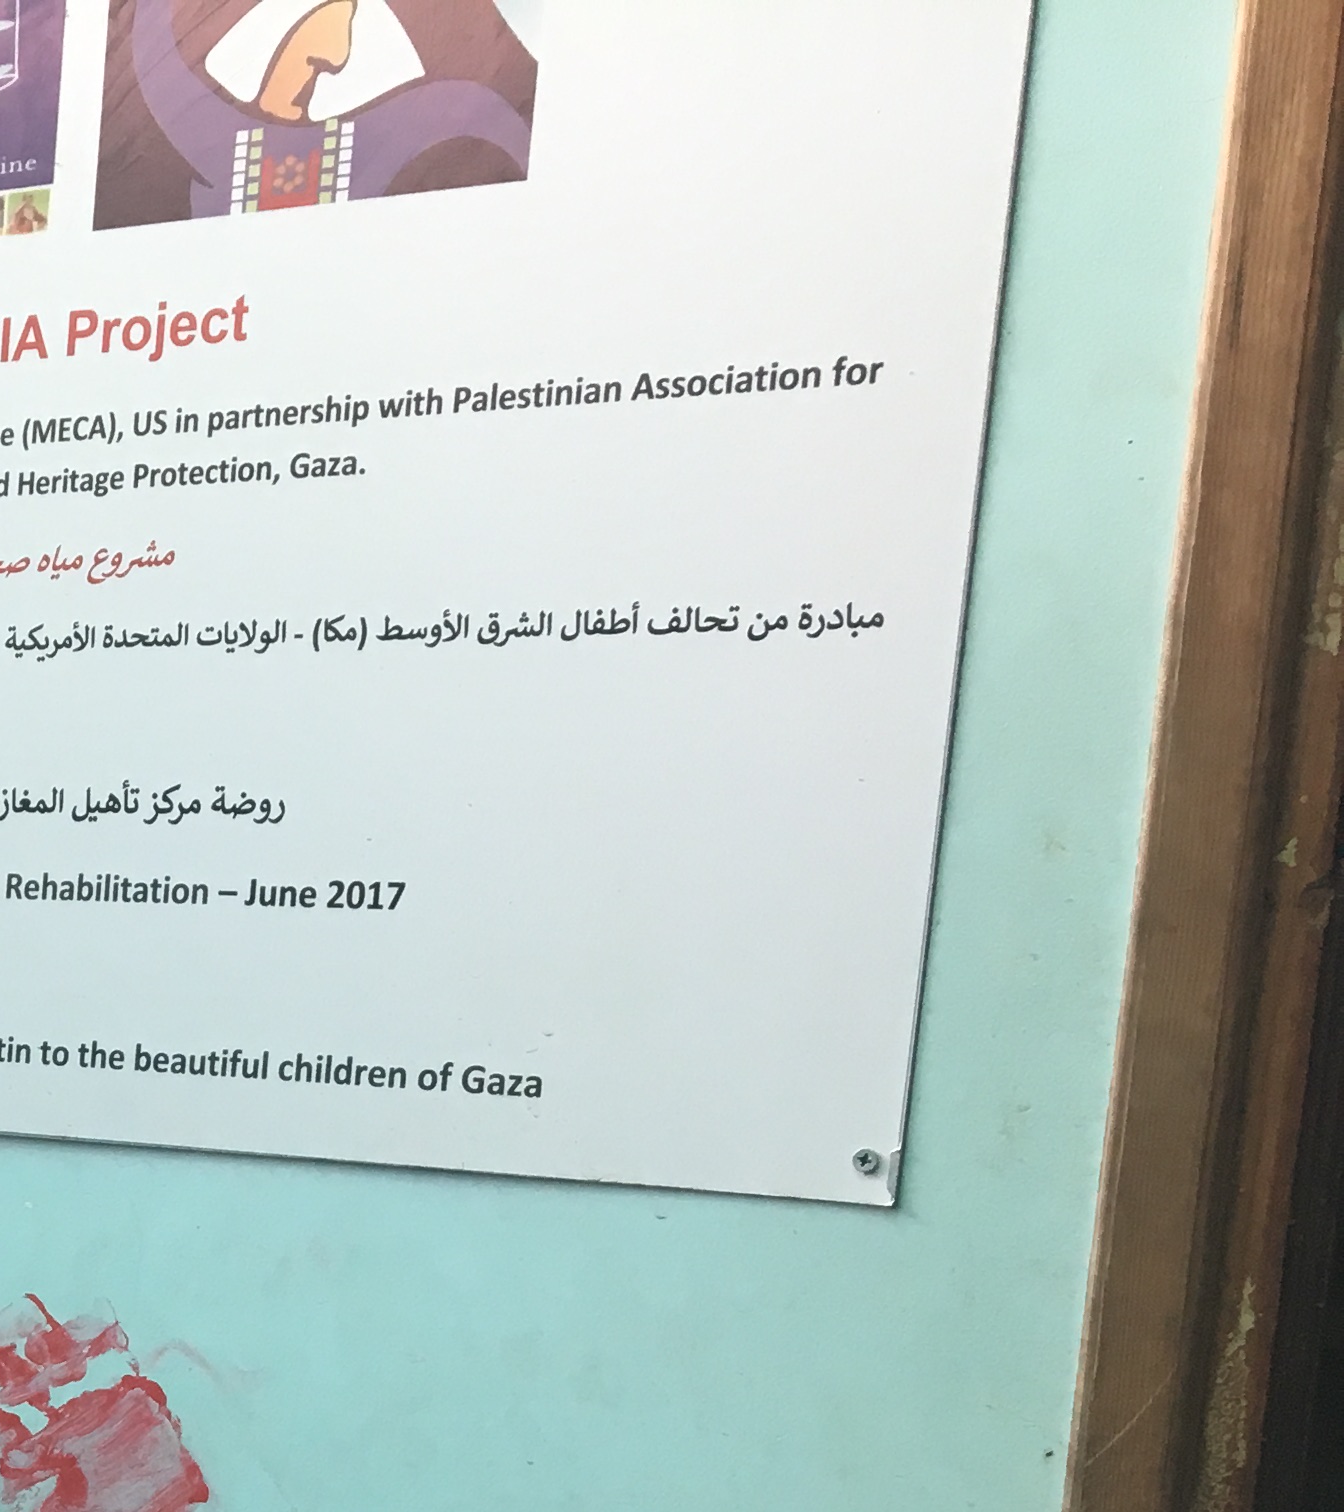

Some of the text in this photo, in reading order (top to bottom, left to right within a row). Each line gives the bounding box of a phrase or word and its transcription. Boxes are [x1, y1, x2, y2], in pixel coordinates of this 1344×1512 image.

[64, 293, 250, 362] Project
[20, 411, 125, 452] (MECA),
[132, 408, 168, 437] US
[175, 405, 199, 434] in
[207, 391, 371, 436] partnership
[378, 386, 444, 419] with
[452, 377, 623, 415] Palestinian
[630, 362, 823, 402] Association
[832, 355, 885, 388] for
[16, 461, 126, 499] Heritage
[132, 453, 282, 491] Protection,
[289, 451, 368, 481] Gaza.
[36, 546, 85, 582] مياه
[85, 539, 177, 586] مشروع
[101, 620, 191, 650] المتحدة
[196, 618, 288, 655] الولايات
[376, 608, 470, 648] الأوسط
[477, 611, 554, 648] الشرق
[559, 600, 641, 641] أطفال
[647, 602, 740, 637] تحالف
[747, 608, 789, 644] من
[798, 601, 885, 636] مبادرة
[4, 623, 96, 663] الأمريكية
[71, 780, 141, 822] تأهيل
[143, 784, 202, 826] مركز
[211, 786, 288, 825] روضة
[5, 873, 210, 906] Rehabilitation
[244, 878, 318, 909] June
[326, 879, 407, 911] 2017
[40, 1039, 71, 1068] to
[77, 1040, 126, 1072] the
[134, 1042, 270, 1081] beautiful
[278, 1052, 408, 1089] children
[416, 1060, 454, 1093] of
[460, 1064, 544, 1101] Gaza
